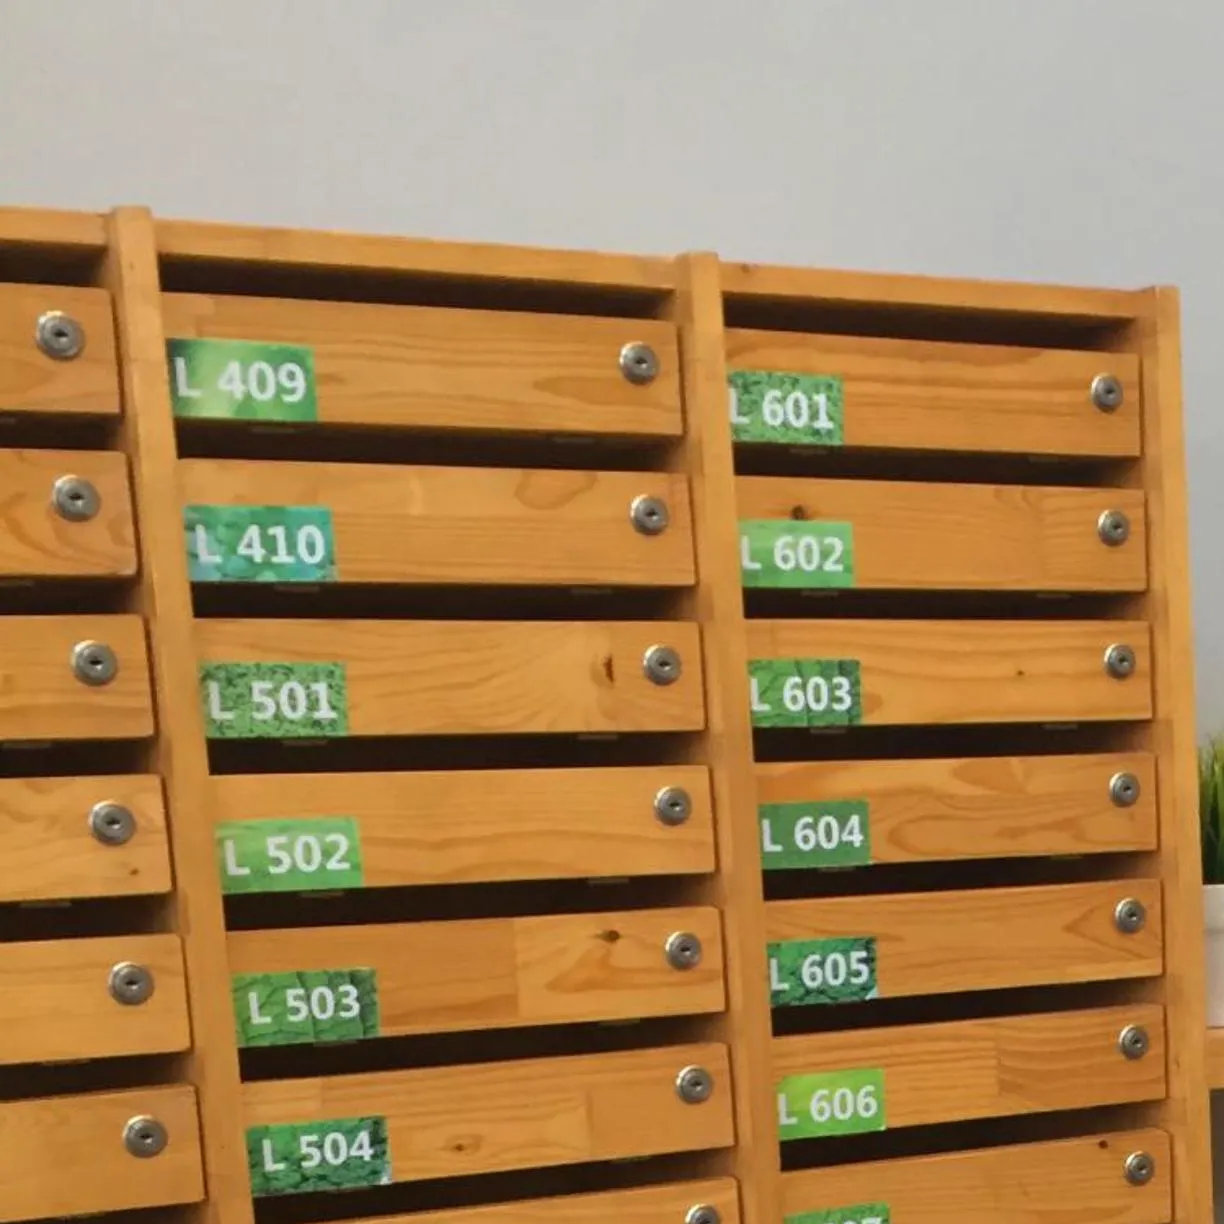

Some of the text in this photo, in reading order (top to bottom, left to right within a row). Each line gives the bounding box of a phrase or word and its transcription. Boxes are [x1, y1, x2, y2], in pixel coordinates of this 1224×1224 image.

[175, 358, 307, 404] L 409
[729, 388, 834, 431] L 601
[191, 524, 325, 564] L 410
[741, 534, 844, 573] L 602
[210, 678, 338, 722] L 501
[750, 675, 852, 713] L 603
[226, 832, 350, 875] L 502
[763, 814, 864, 853] L 604
[770, 951, 869, 990] L 605
[249, 984, 361, 1024] L 503
[779, 1085, 878, 1126] L 606
[263, 1130, 374, 1172] L 504
